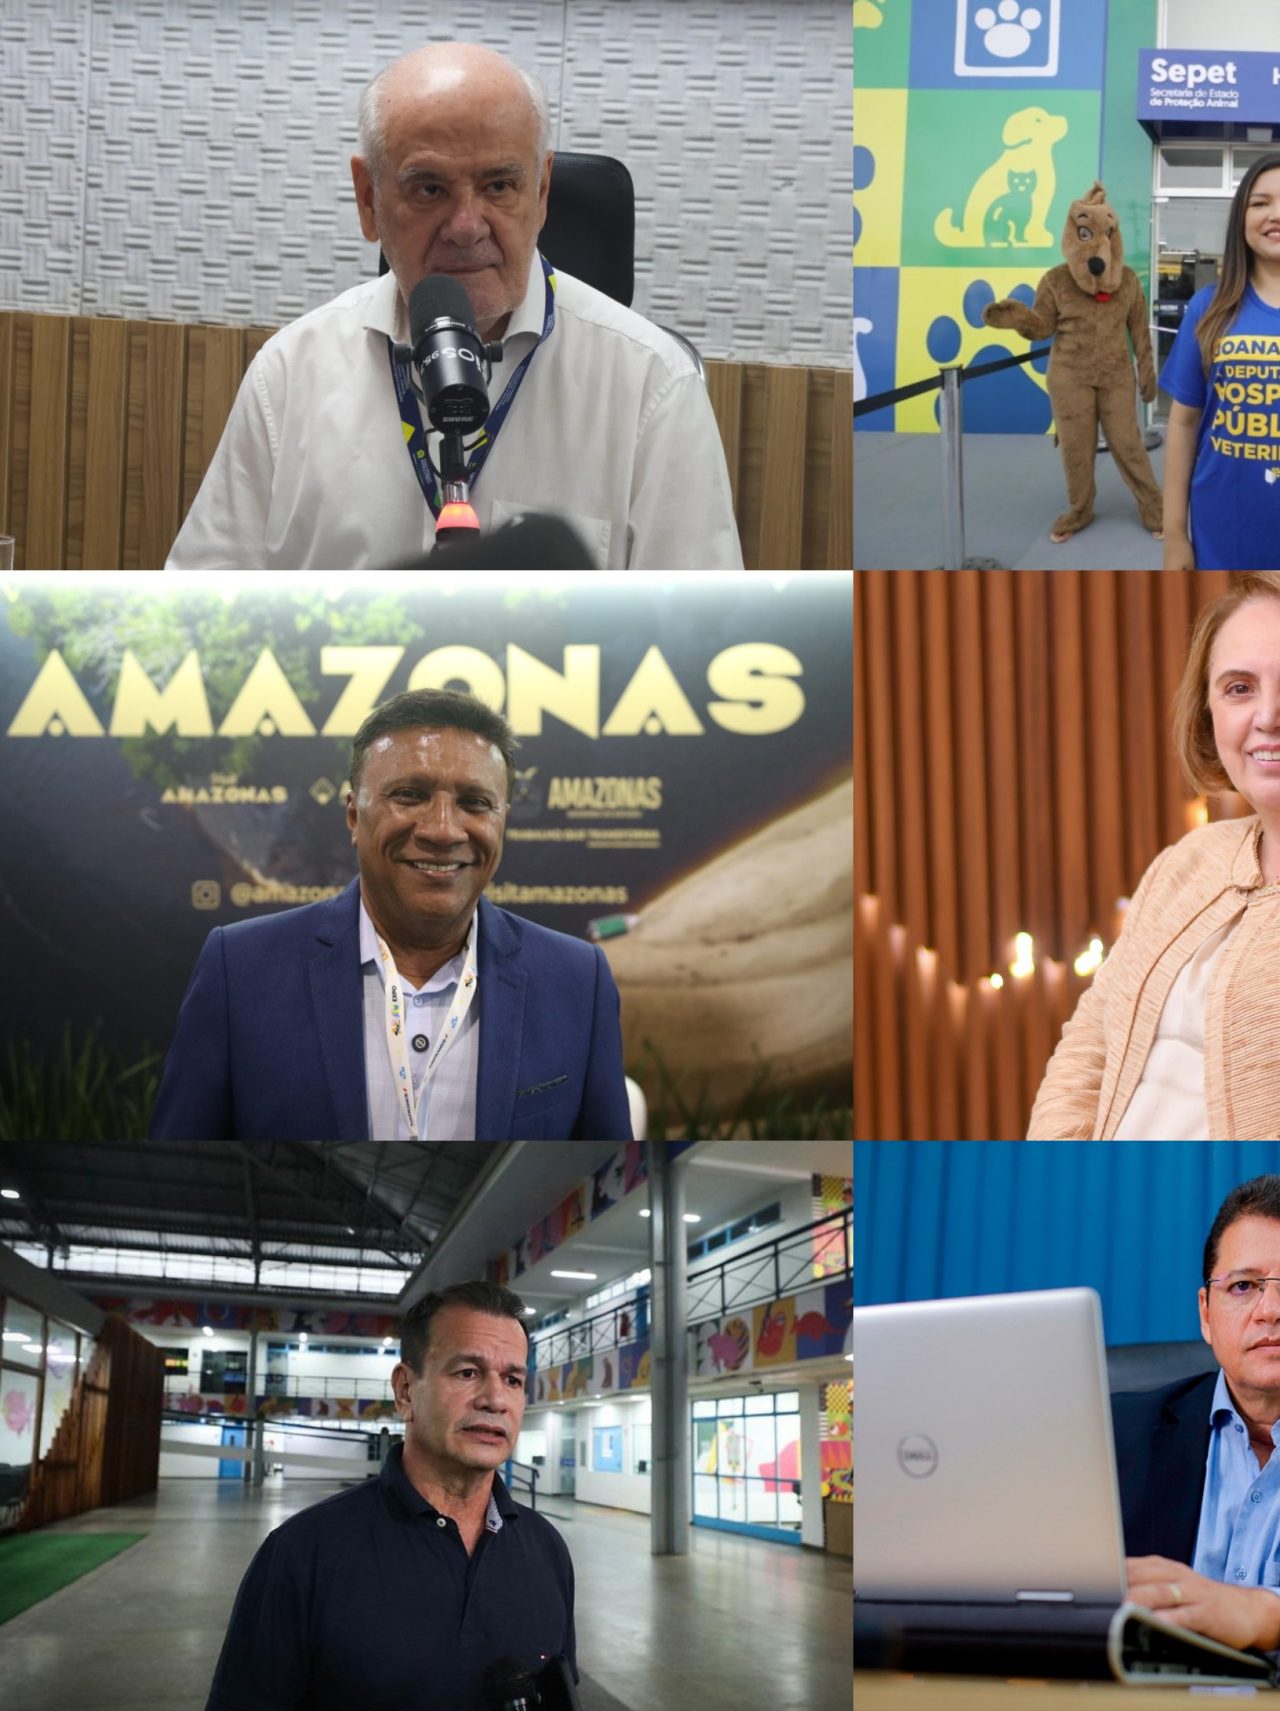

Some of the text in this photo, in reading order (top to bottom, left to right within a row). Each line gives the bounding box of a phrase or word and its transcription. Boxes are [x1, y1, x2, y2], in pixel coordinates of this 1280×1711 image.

[1151, 58, 1237, 88] Sepet
[1150, 88, 1193, 98] Secretaria
[1209, 89, 1239, 99] Estado
[1207, 99, 1239, 108] Animal
[6, 642, 806, 740] AMAZONAS
[547, 776, 663, 810] AMAZONAS
